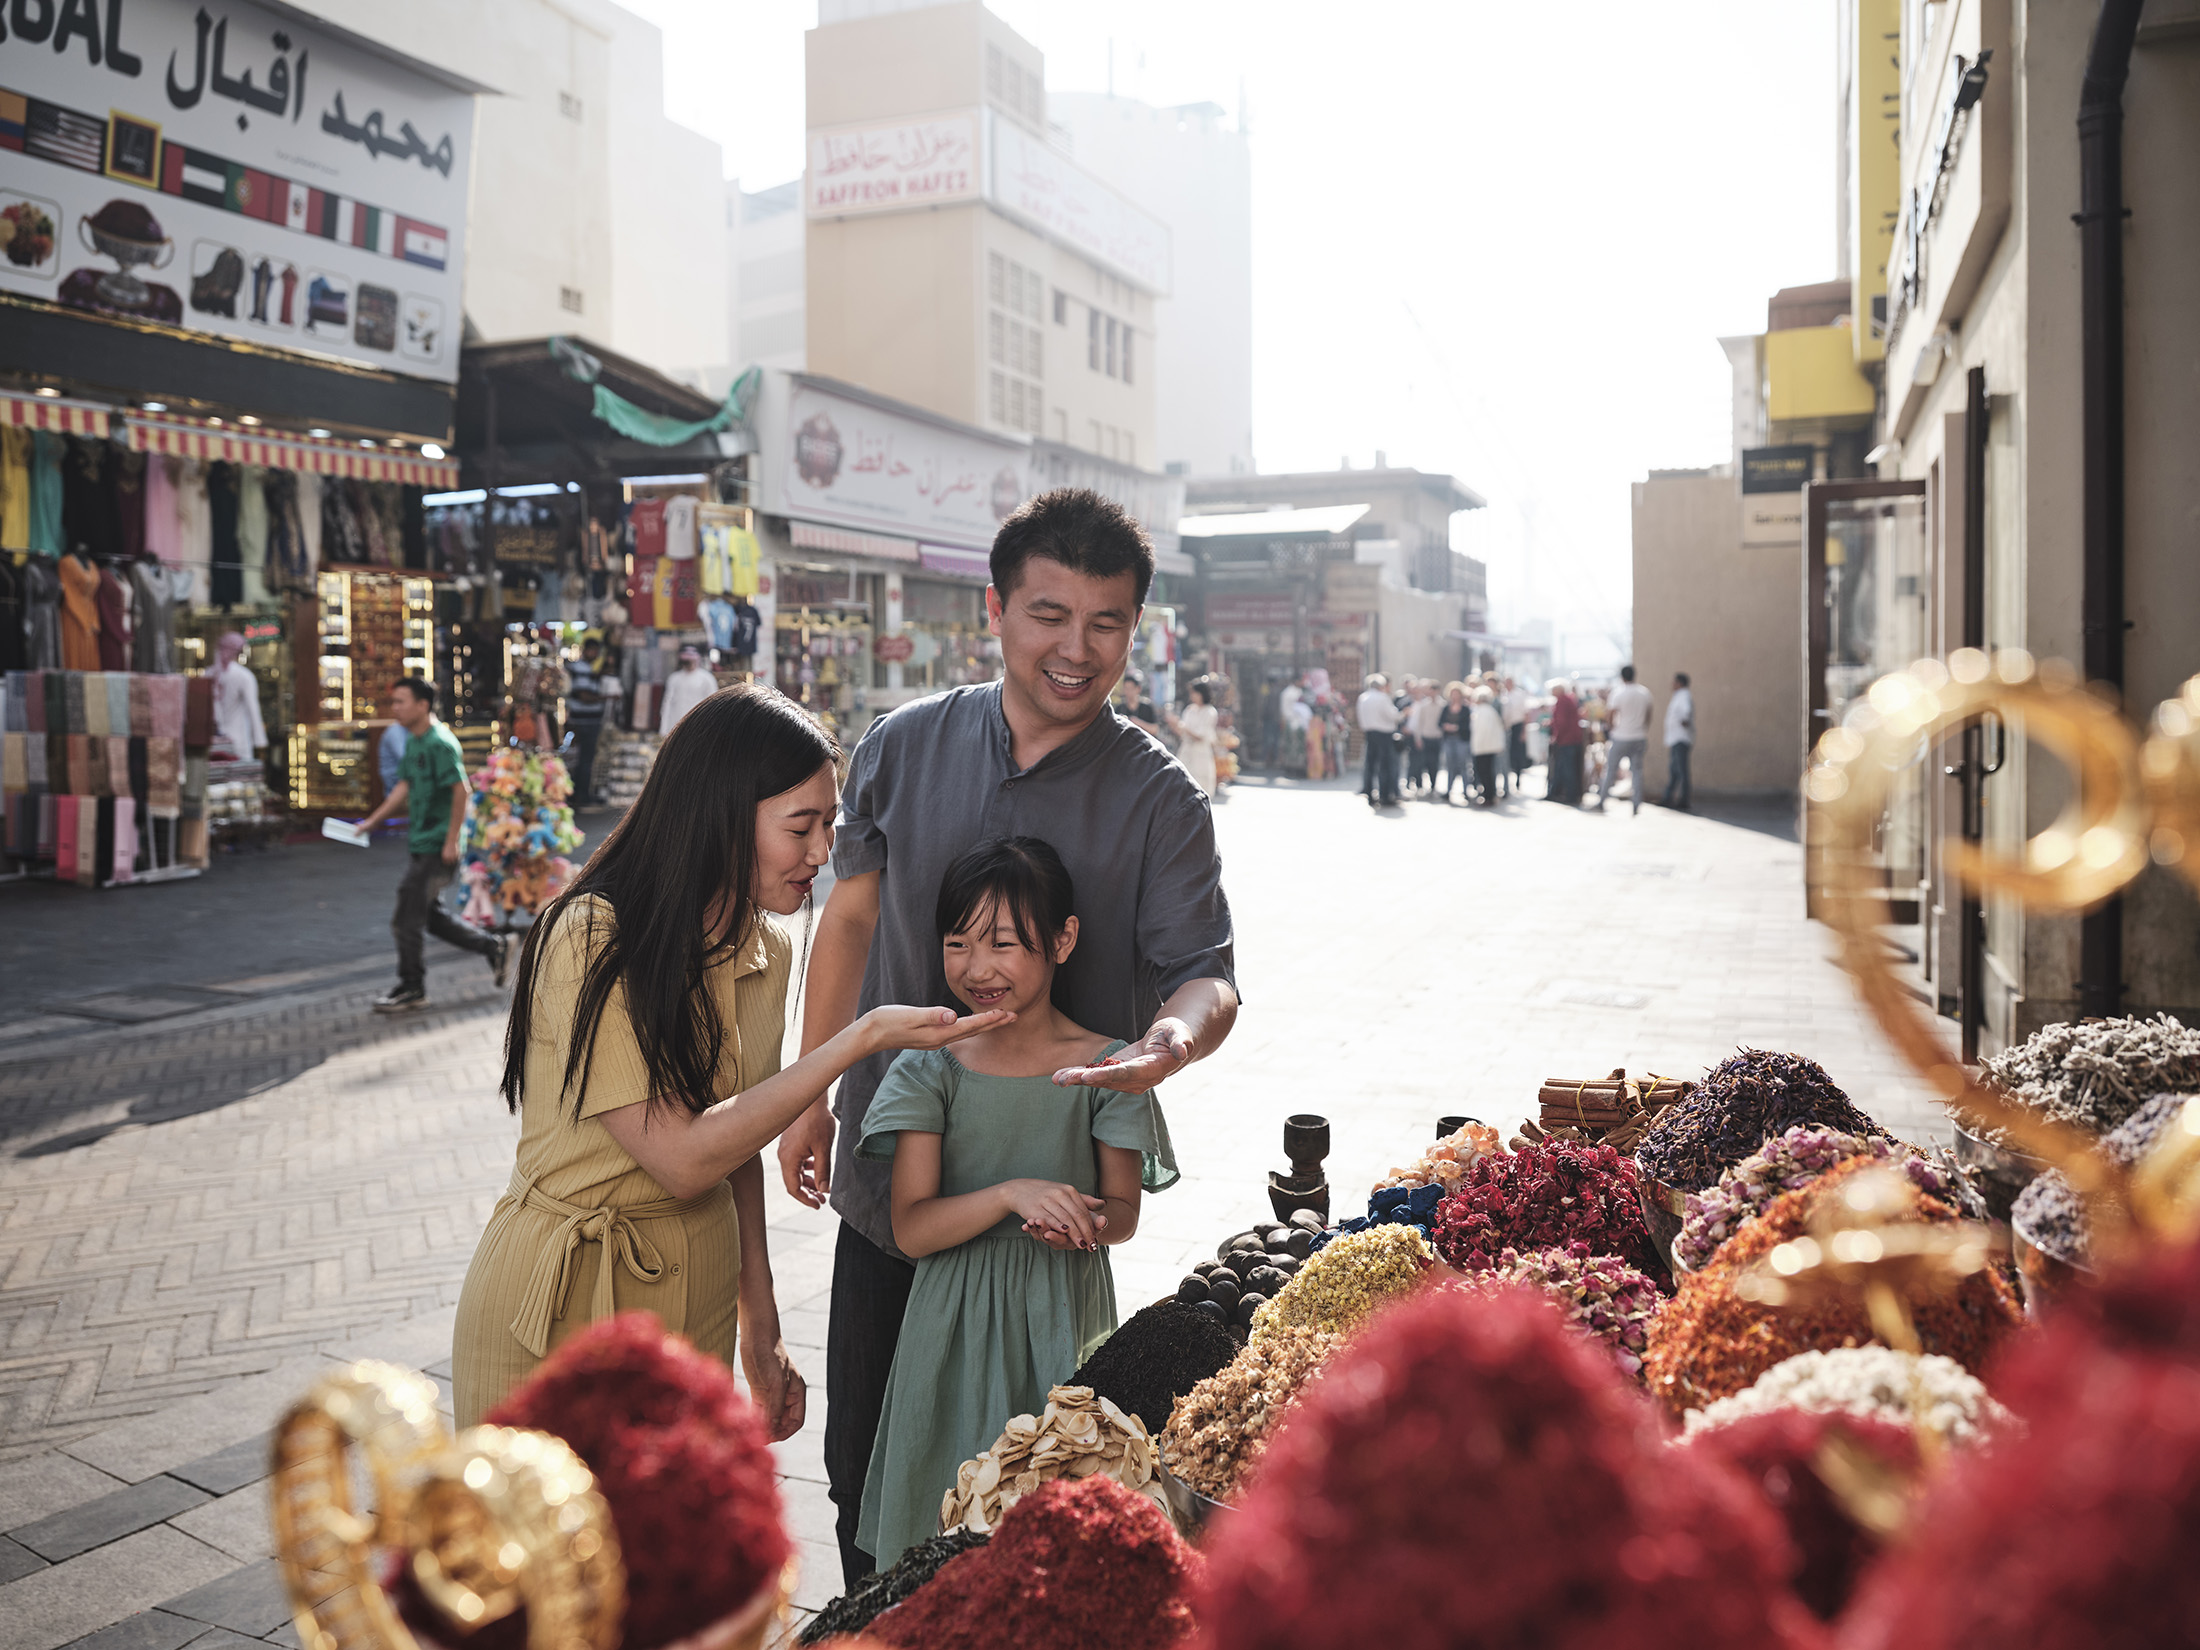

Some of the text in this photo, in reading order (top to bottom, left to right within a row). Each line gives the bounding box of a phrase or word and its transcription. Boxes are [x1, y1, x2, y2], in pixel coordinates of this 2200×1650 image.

[321, 89, 455, 179] محمد
[817, 168, 969, 207] SAFFRON HAFEZ
